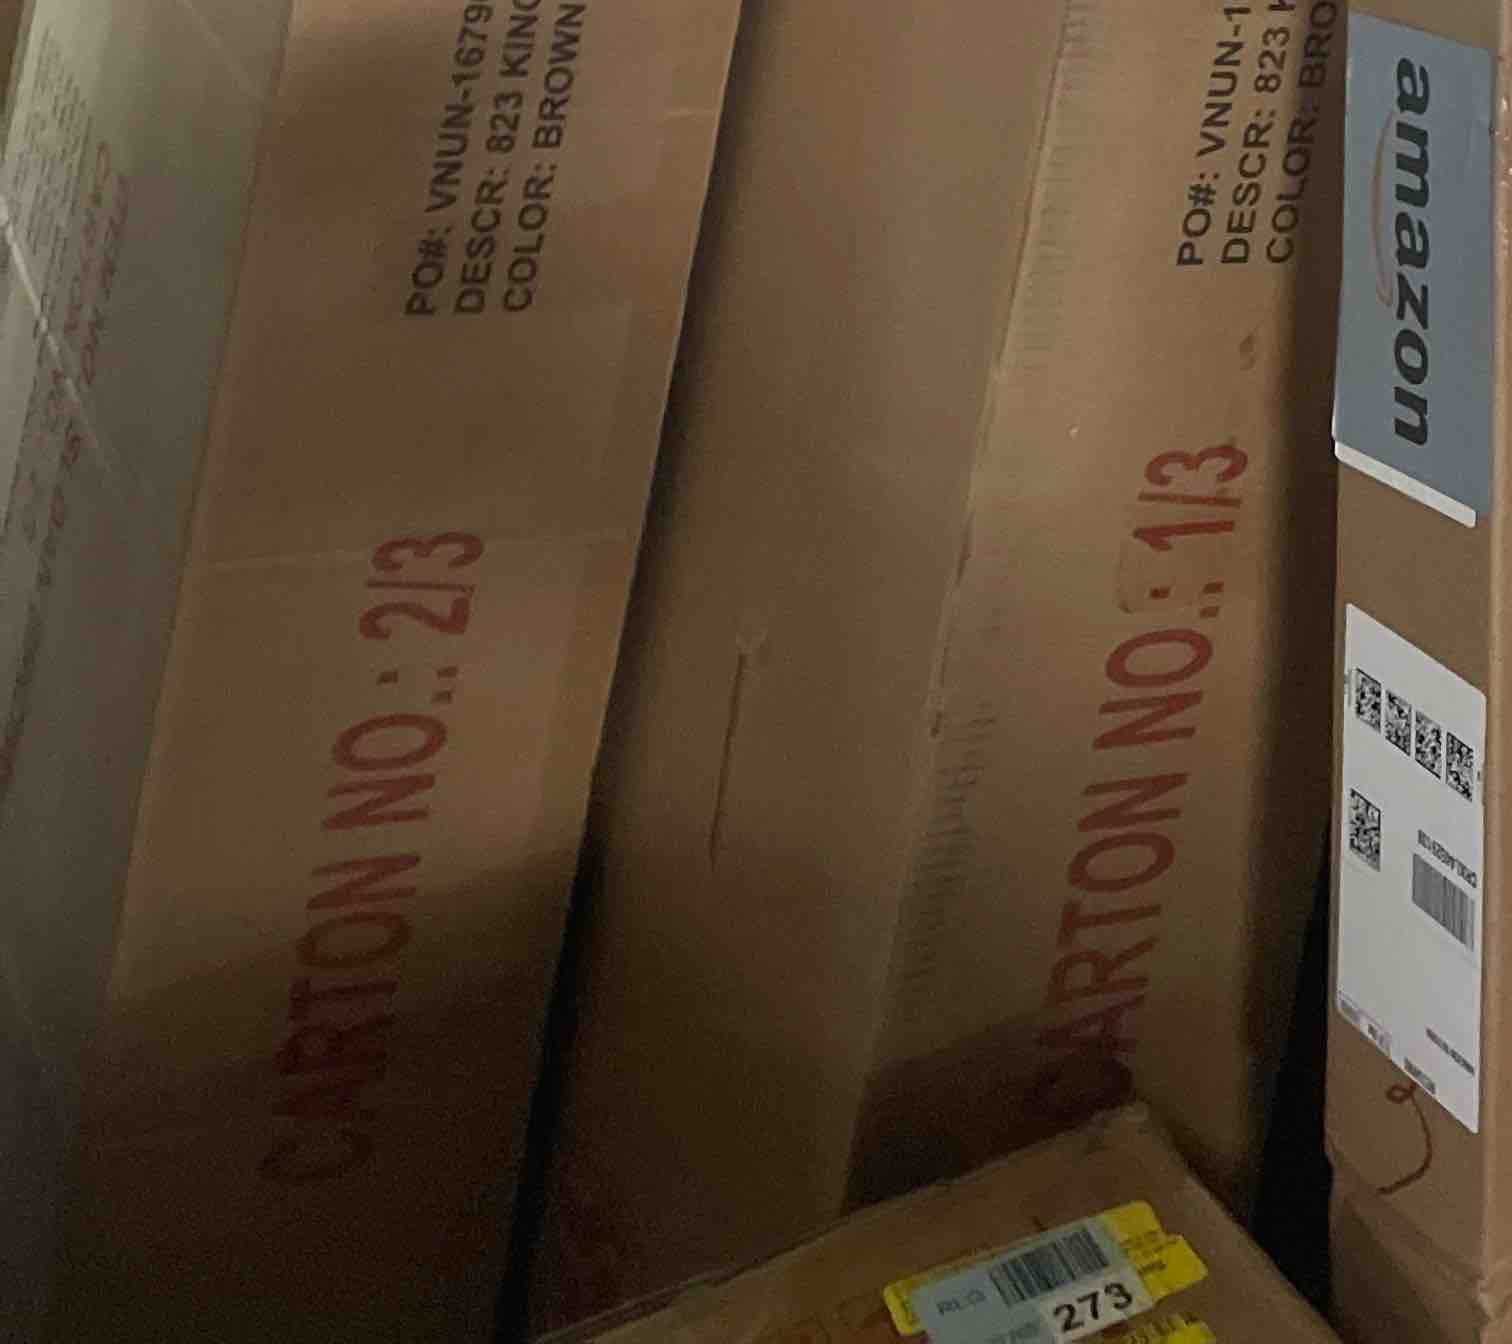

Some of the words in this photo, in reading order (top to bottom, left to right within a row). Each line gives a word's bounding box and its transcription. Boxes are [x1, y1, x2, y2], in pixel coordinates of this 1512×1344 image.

[452, 167, 510, 315] DESCR:
[485, 90, 524, 155] 823
[502, 163, 558, 313] COLOR:
[531, 2, 588, 150] BROWN
[1176, 170, 1220, 267] PO#:
[1220, 106, 1277, 265] DESCR:
[1254, 25, 1292, 95] 823
[1265, 103, 1320, 264] COLOR:
[403, 225, 453, 317] PO#:
[1394, 56, 1431, 446] amazon
[1131, 442, 1250, 554] 1/3
[358, 530, 485, 641] 2/3
[1091, 579, 1226, 752] NO.:
[320, 664, 460, 832] NO.:
[257, 852, 422, 1184] CARTON
[1053, 1281, 1134, 1334] 273
